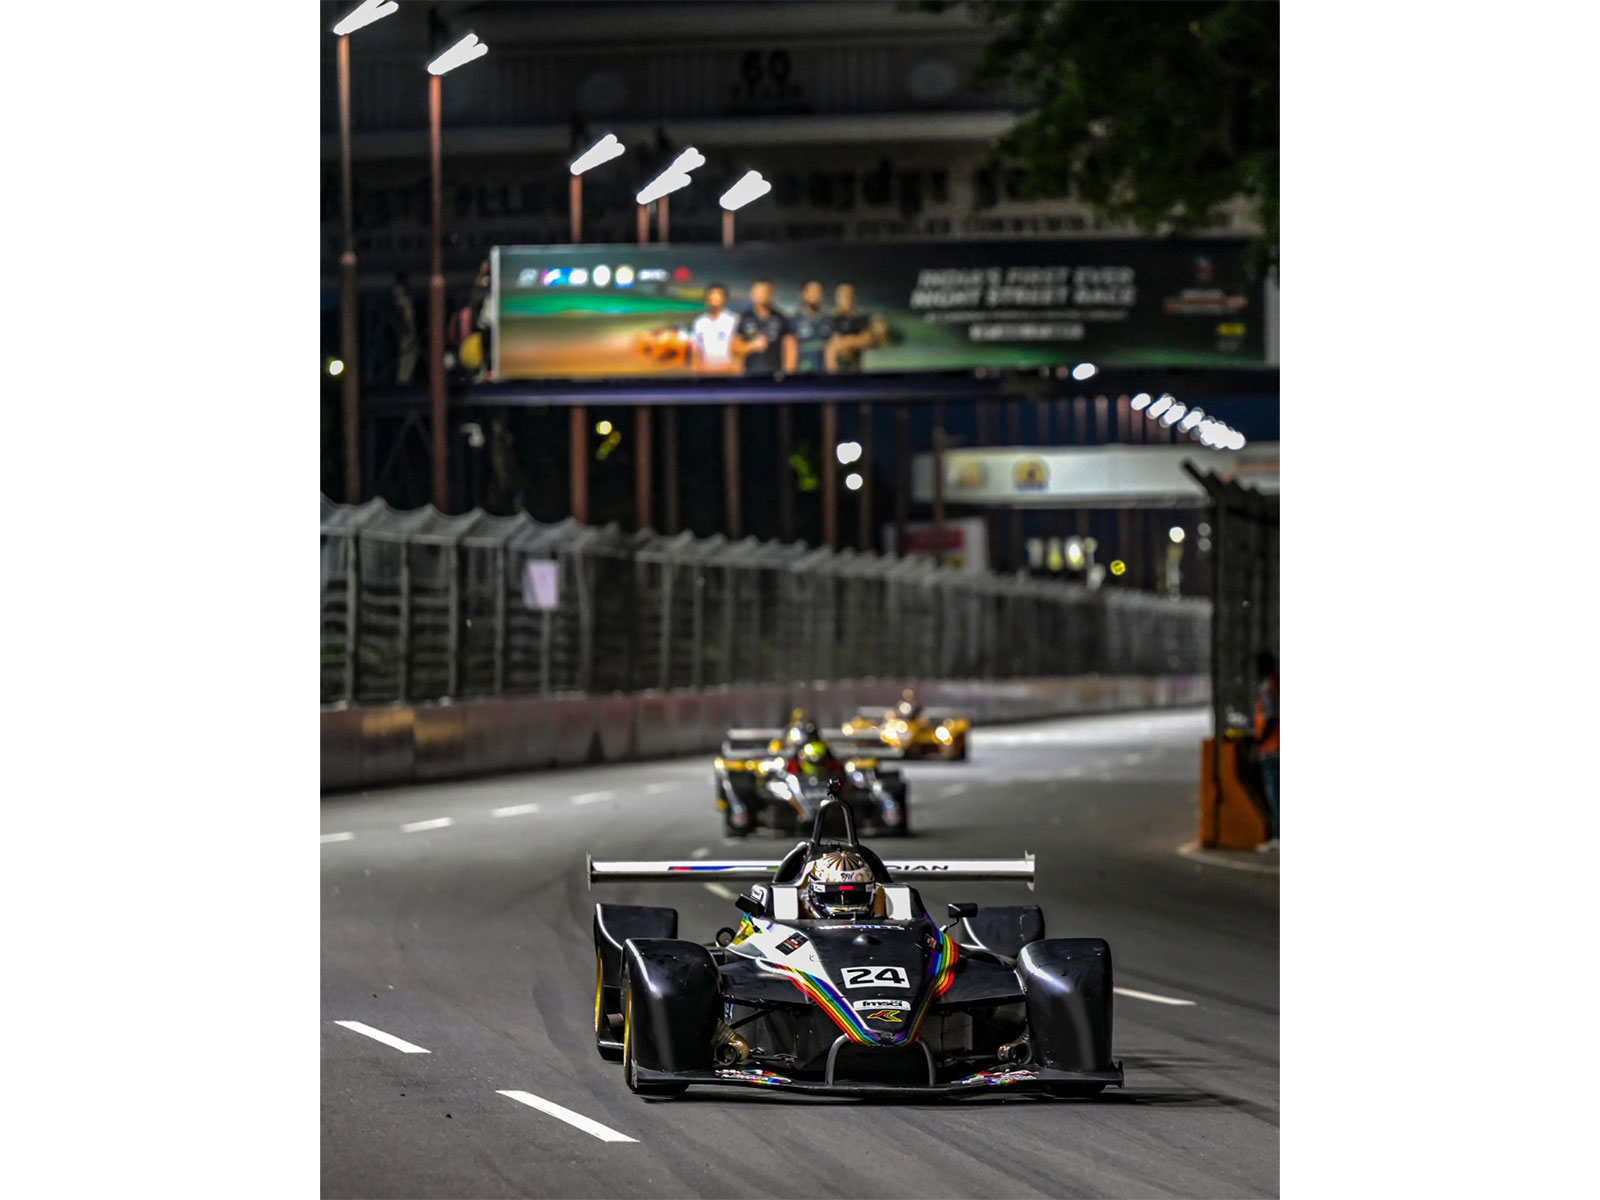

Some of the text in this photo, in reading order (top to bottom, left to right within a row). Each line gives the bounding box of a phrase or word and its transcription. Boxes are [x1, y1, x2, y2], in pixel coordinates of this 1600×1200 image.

[1005, 266, 1071, 286] FIRST
[1073, 265, 1136, 285] EVER
[910, 286, 1137, 307] NIGHT STREET RACE
[846, 967, 906, 985] 24
